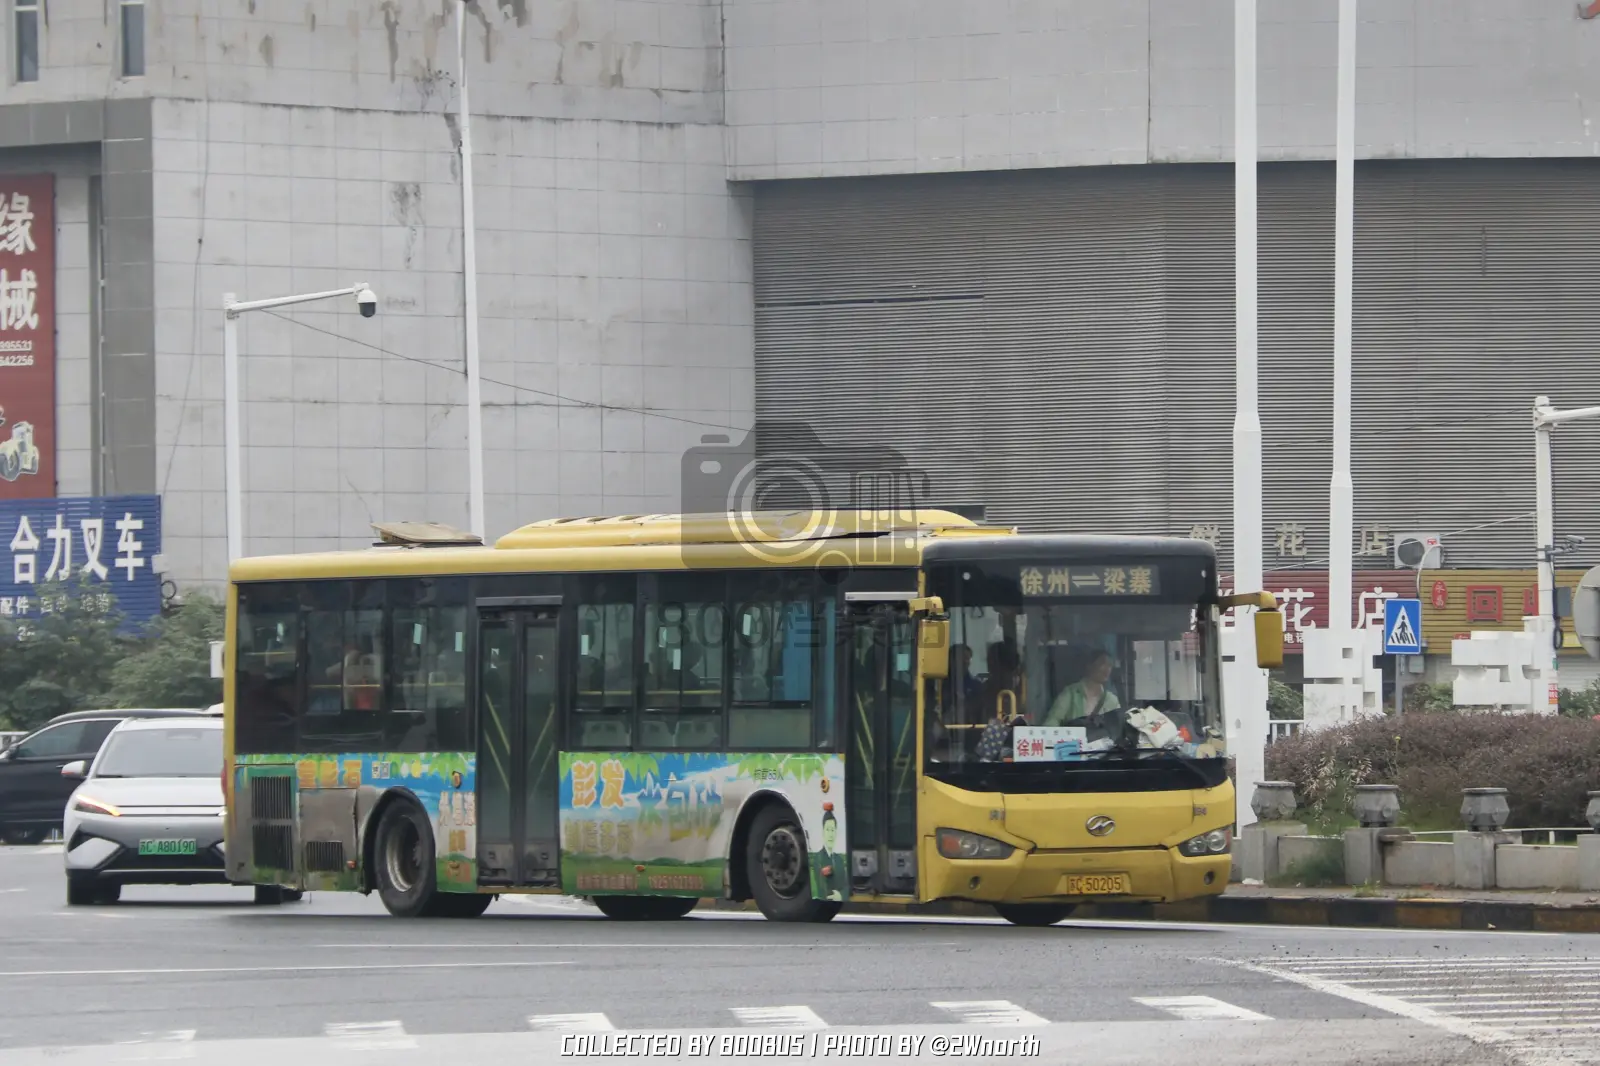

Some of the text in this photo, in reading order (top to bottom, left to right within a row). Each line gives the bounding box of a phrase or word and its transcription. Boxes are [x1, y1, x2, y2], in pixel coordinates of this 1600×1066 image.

[0, 268, 39, 330] 械
[9, 512, 146, 584] 合力叉车
[1019, 566, 1153, 595] 徐州 梁寨
[1017, 738, 1044, 757] 徐州
[571, 759, 625, 809] 彭发
